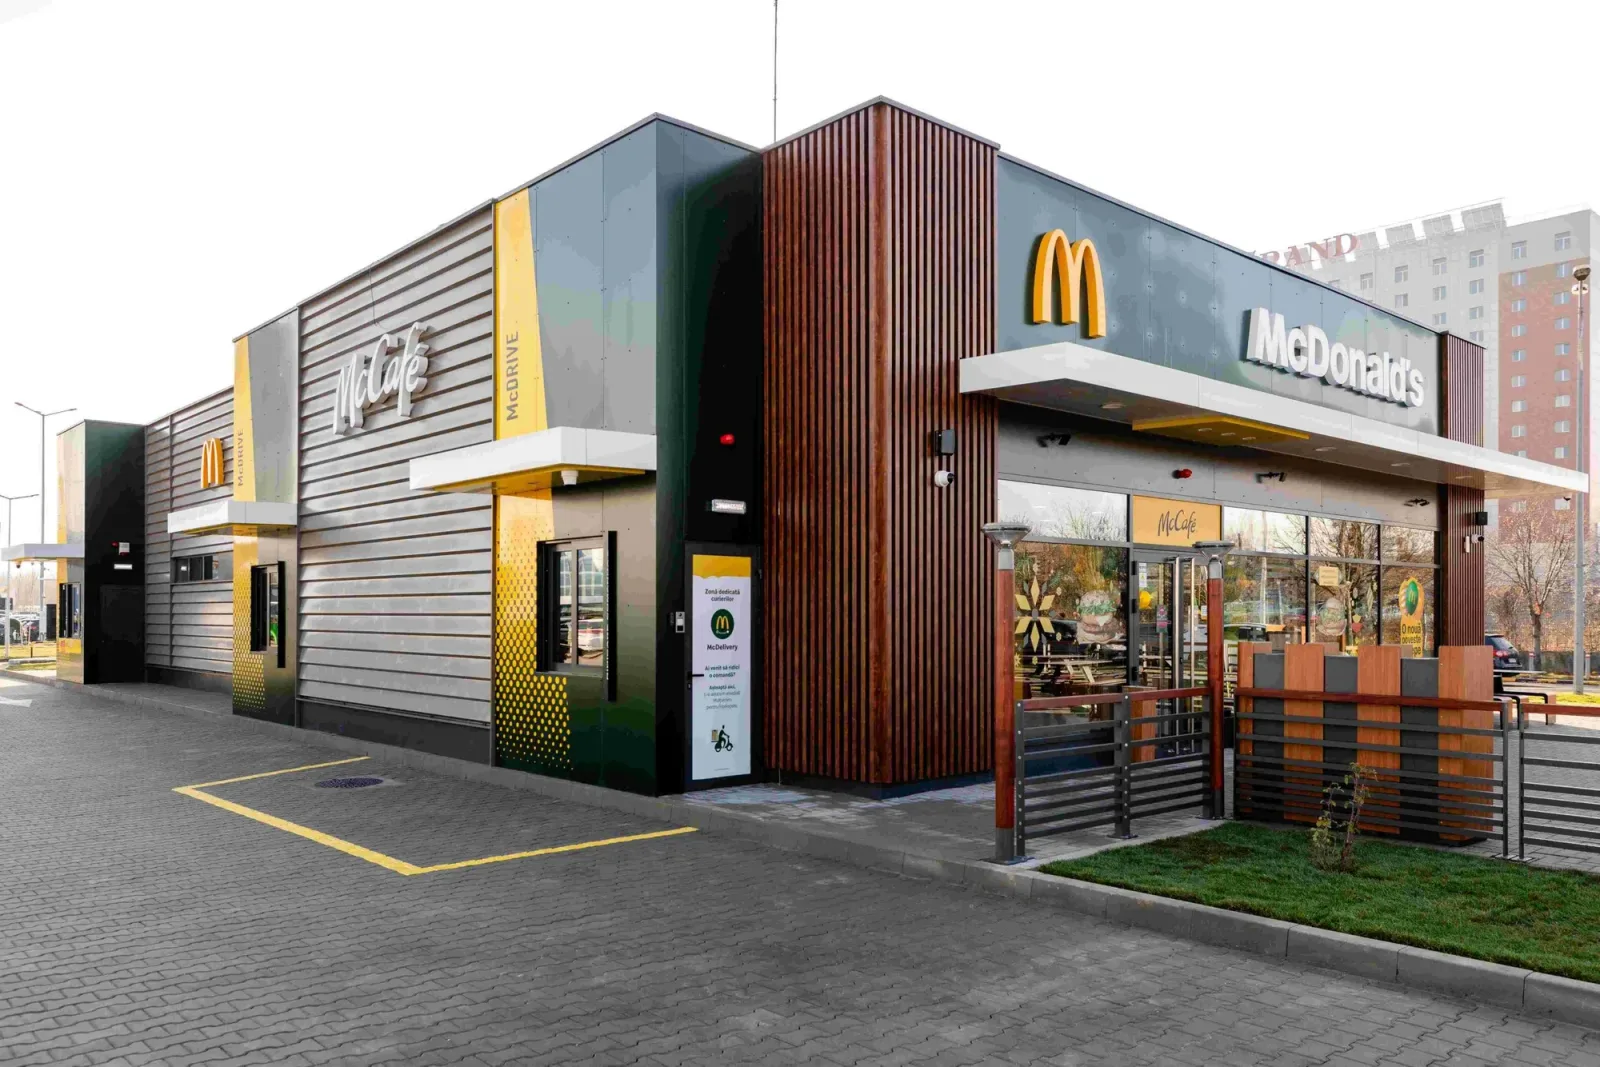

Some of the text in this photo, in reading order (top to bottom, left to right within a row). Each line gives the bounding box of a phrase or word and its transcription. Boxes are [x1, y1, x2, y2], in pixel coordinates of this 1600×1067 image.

[333, 321, 430, 435] McCafé
[506, 331, 519, 422] McDRIVE
[1246, 307, 1425, 408] McDonald's
[1157, 508, 1197, 539] McCafé
[706, 644, 739, 652] McDelivery
[1401, 623, 1422, 634] O nouă
